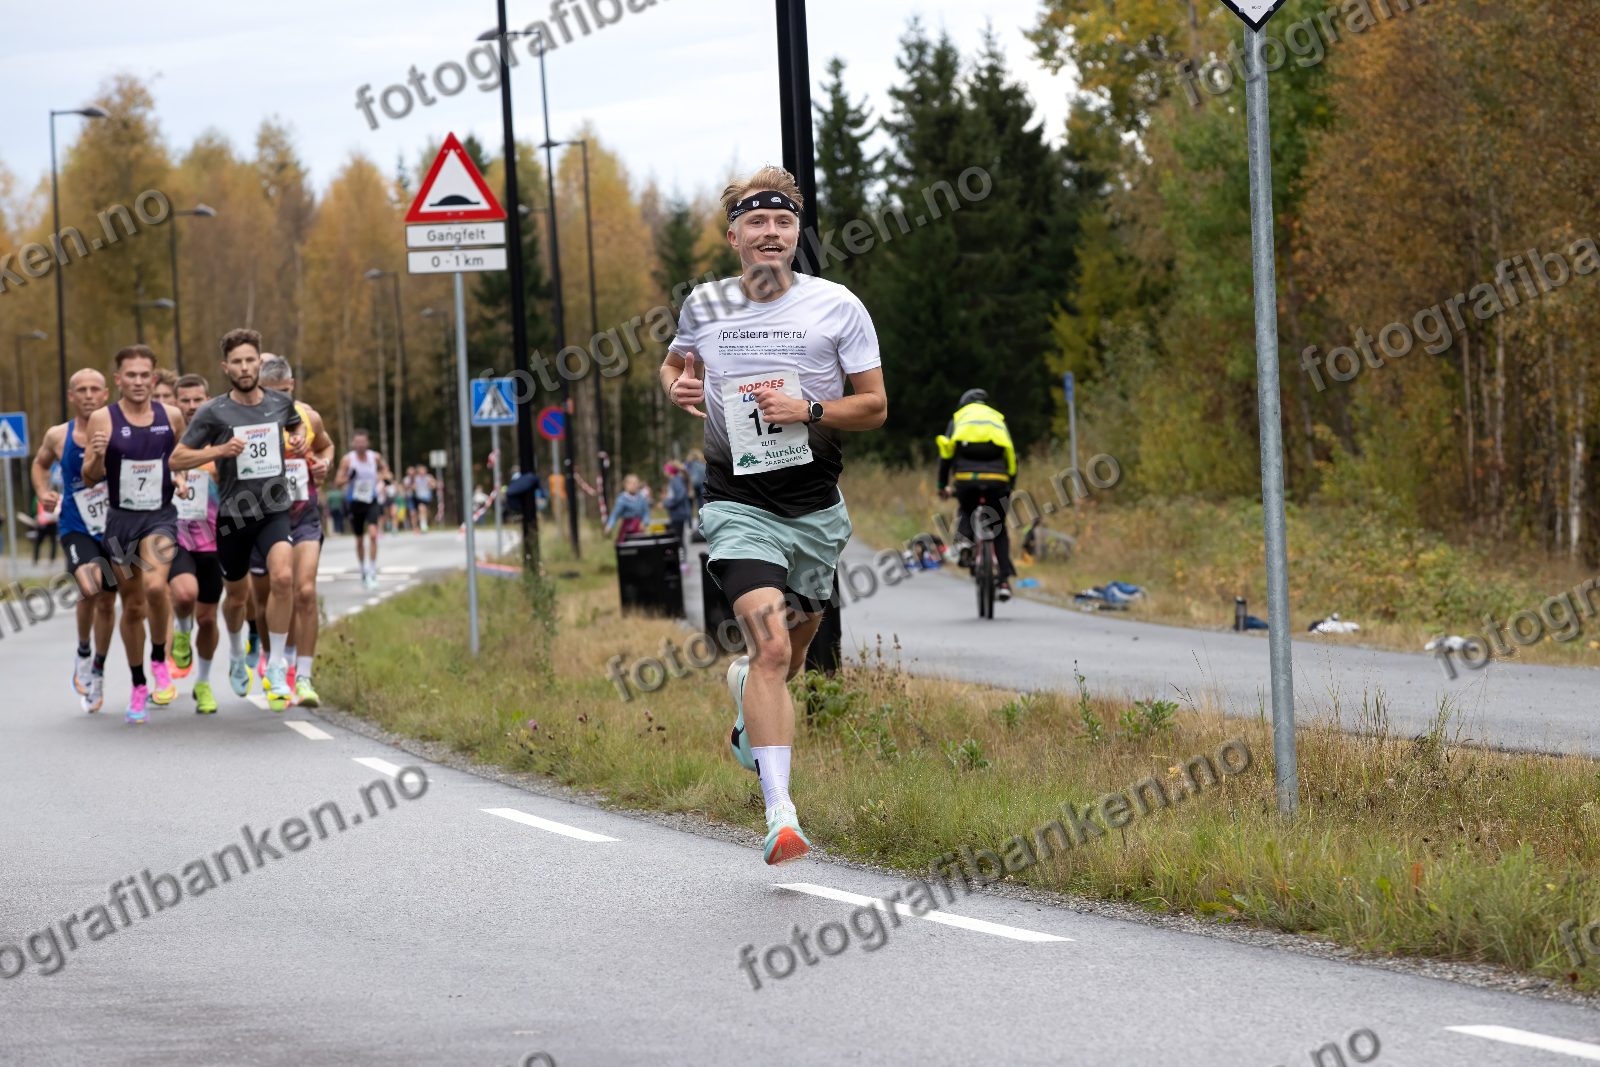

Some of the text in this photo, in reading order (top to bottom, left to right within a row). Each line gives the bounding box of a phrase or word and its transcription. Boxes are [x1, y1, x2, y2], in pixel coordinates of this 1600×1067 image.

[426, 228, 486, 243] Gangfelt
[249, 441, 267, 459] 38
[765, 444, 809, 460] Aurskog
[138, 477, 147, 491] 7
